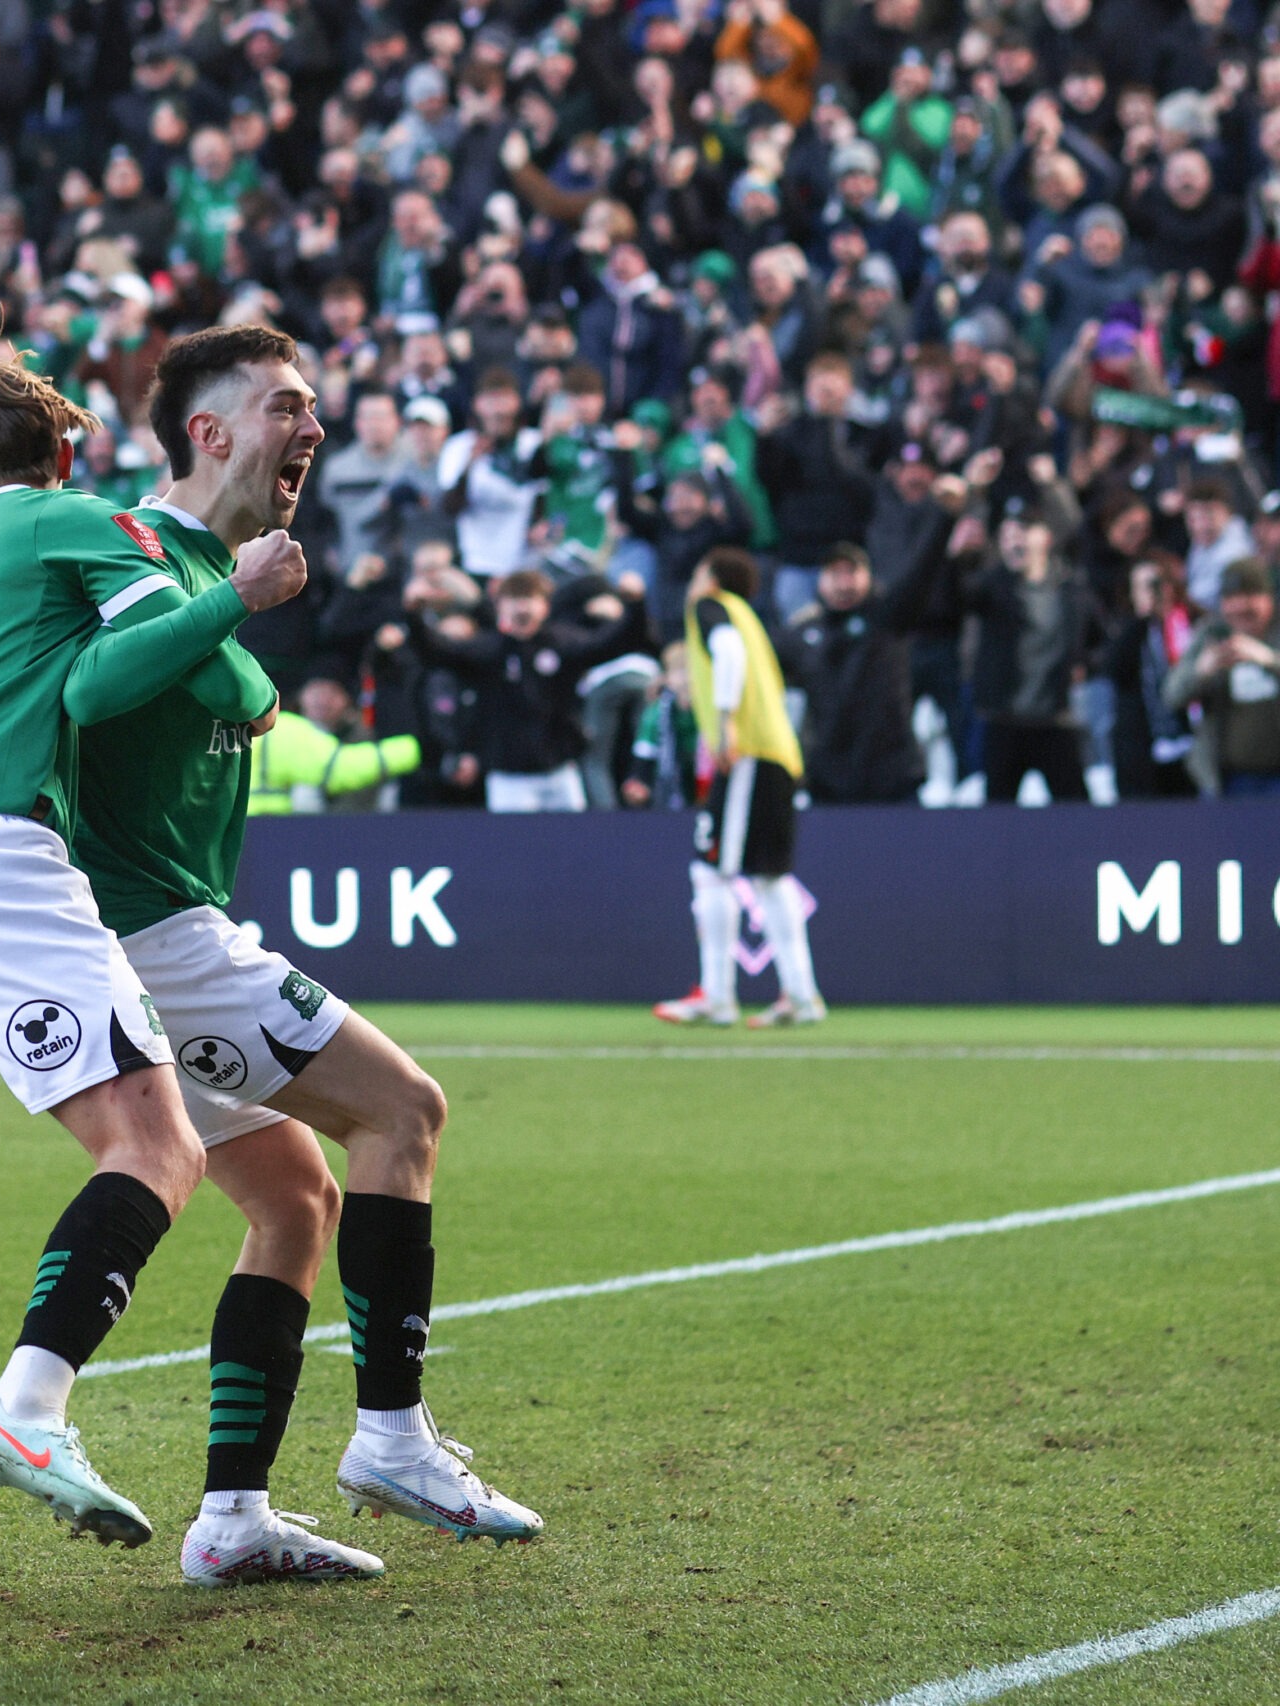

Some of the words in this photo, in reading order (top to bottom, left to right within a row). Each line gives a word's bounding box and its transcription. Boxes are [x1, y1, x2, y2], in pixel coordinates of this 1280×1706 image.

[1097, 860, 1280, 946] MI
[26, 1035, 74, 1063] retain
[208, 1060, 242, 1086] retain
